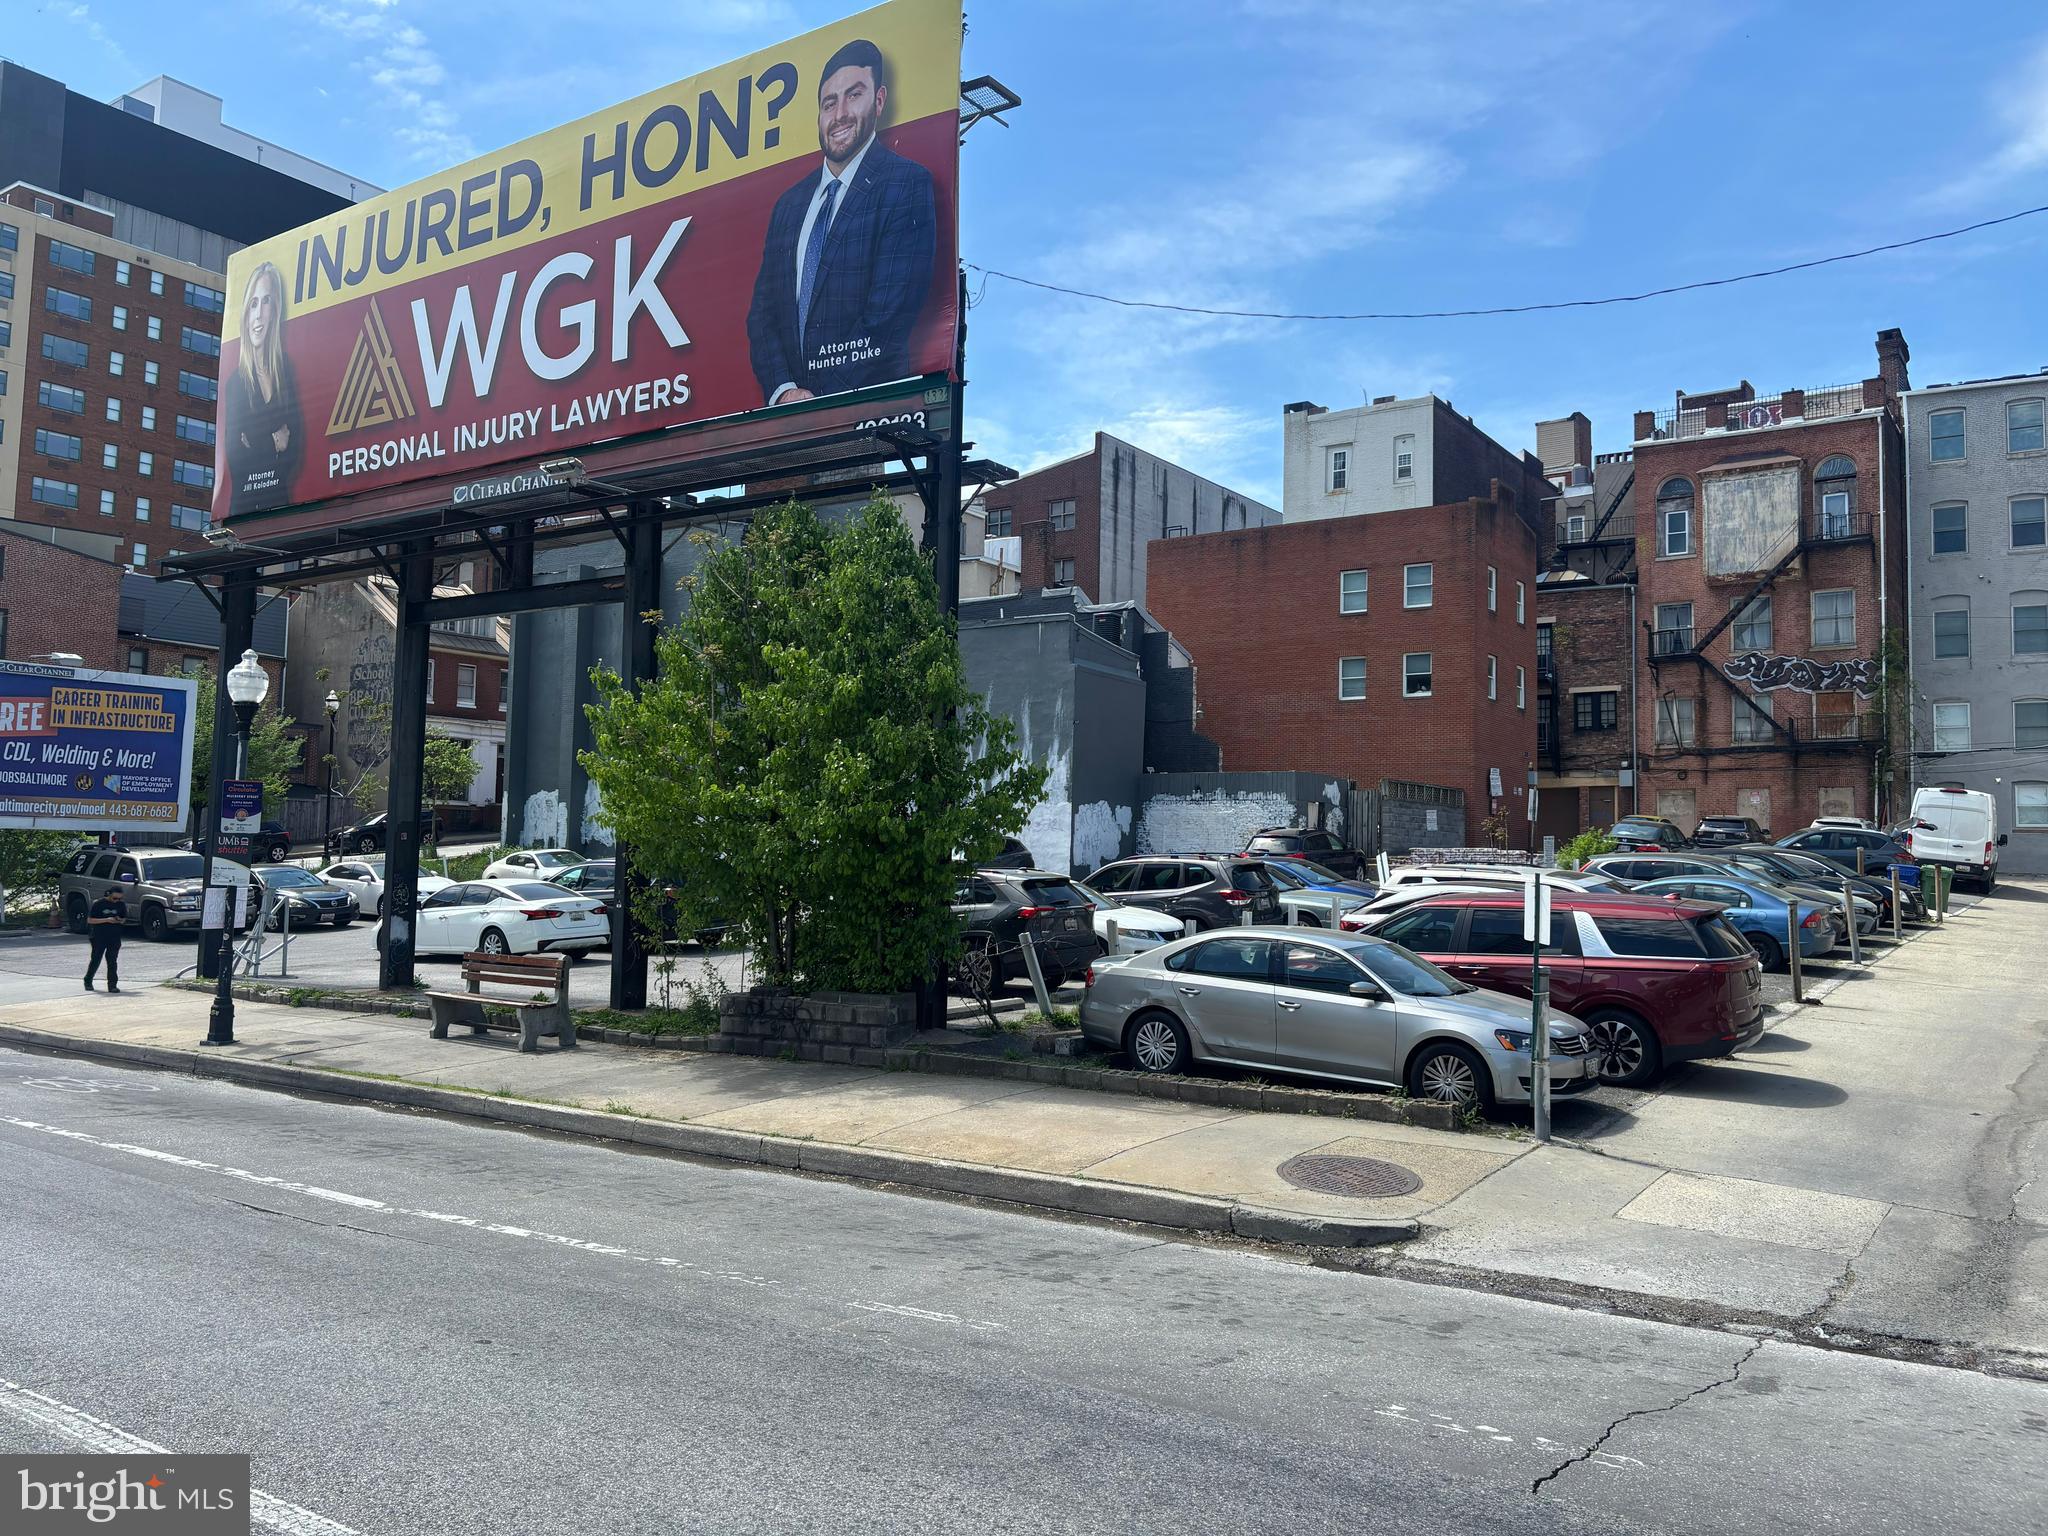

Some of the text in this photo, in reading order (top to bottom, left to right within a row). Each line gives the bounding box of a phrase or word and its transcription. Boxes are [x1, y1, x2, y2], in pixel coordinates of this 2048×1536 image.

[293, 62, 799, 304] INJURED, HON?
[410, 215, 693, 408] WGK
[818, 336, 871, 356] Attorney
[808, 346, 881, 370] Hunter Duke
[328, 373, 690, 478] PERSONAL INJURY LAWYERS
[247, 470, 275, 482] Attorney
[253, 478, 280, 490] Kolodner
[469, 474, 567, 501] CLEARCHAN
[54, 690, 160, 711] CAREER TRAINING
[52, 709, 173, 730] IN INFRASTRUCTURE
[3, 741, 156, 770] CDL, Welding & More!
[109, 802, 173, 818] 443-687-6682
[218, 835, 240, 846] UMB
